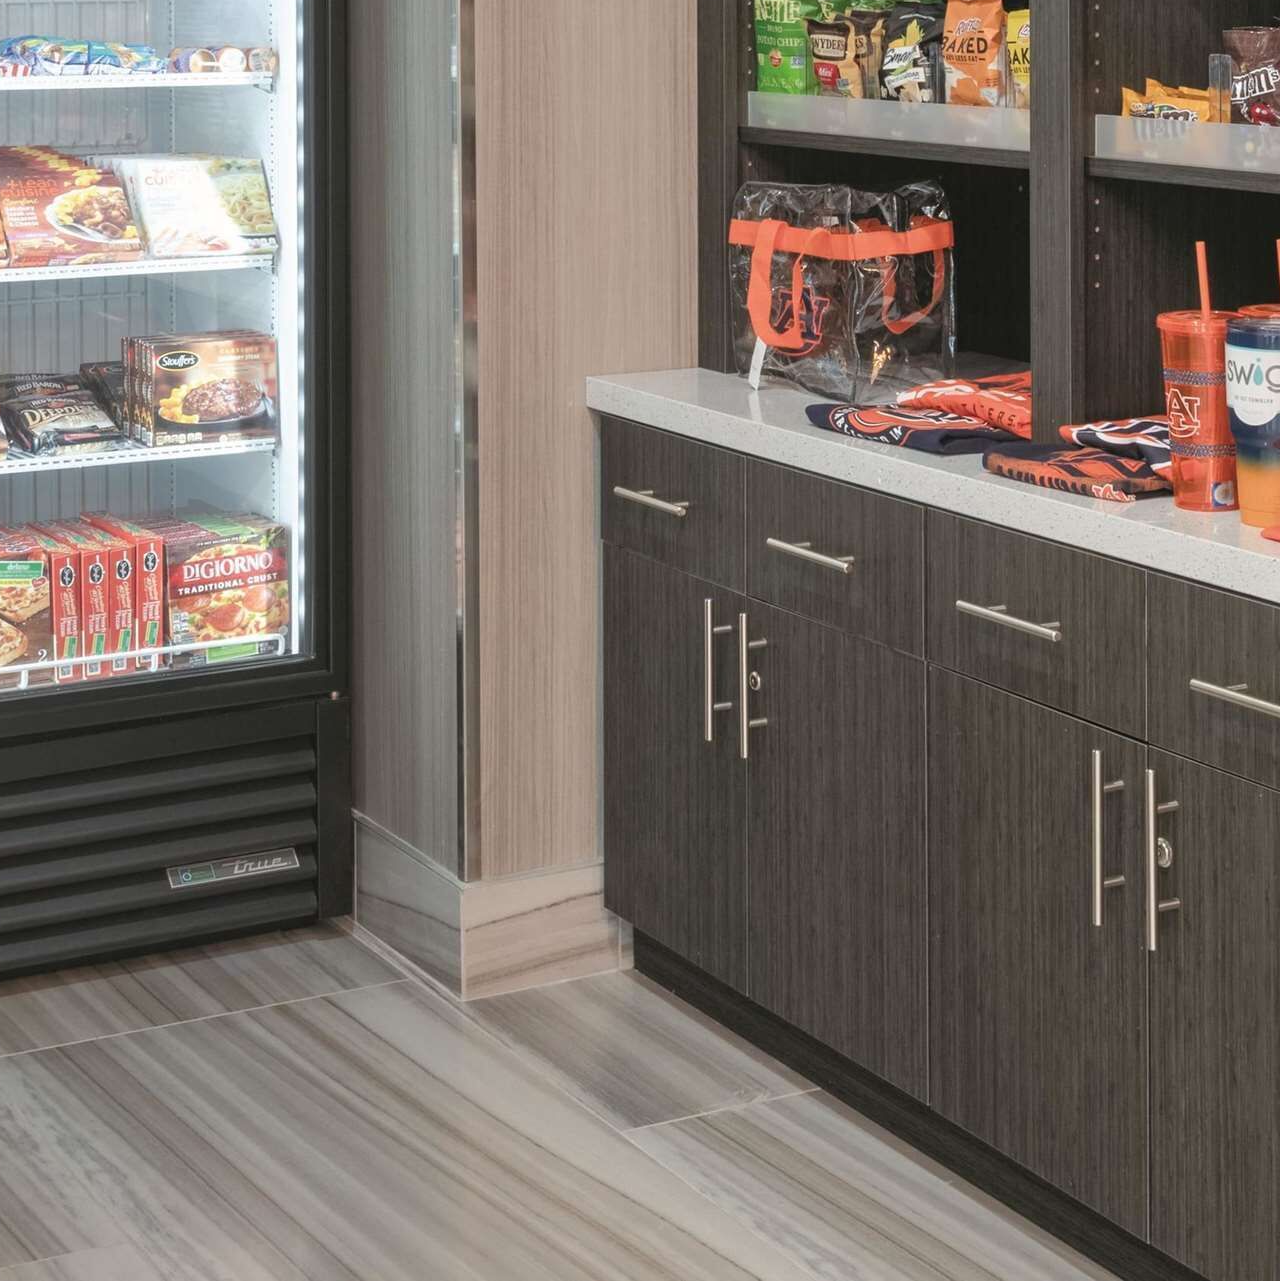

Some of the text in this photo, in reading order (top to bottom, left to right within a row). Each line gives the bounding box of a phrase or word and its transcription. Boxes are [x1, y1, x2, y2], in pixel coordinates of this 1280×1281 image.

[1008, 48, 1030, 65] BAK
[161, 354, 197, 368] Stouffer's
[178, 572, 278, 596] TRADITIONAL CRUST
